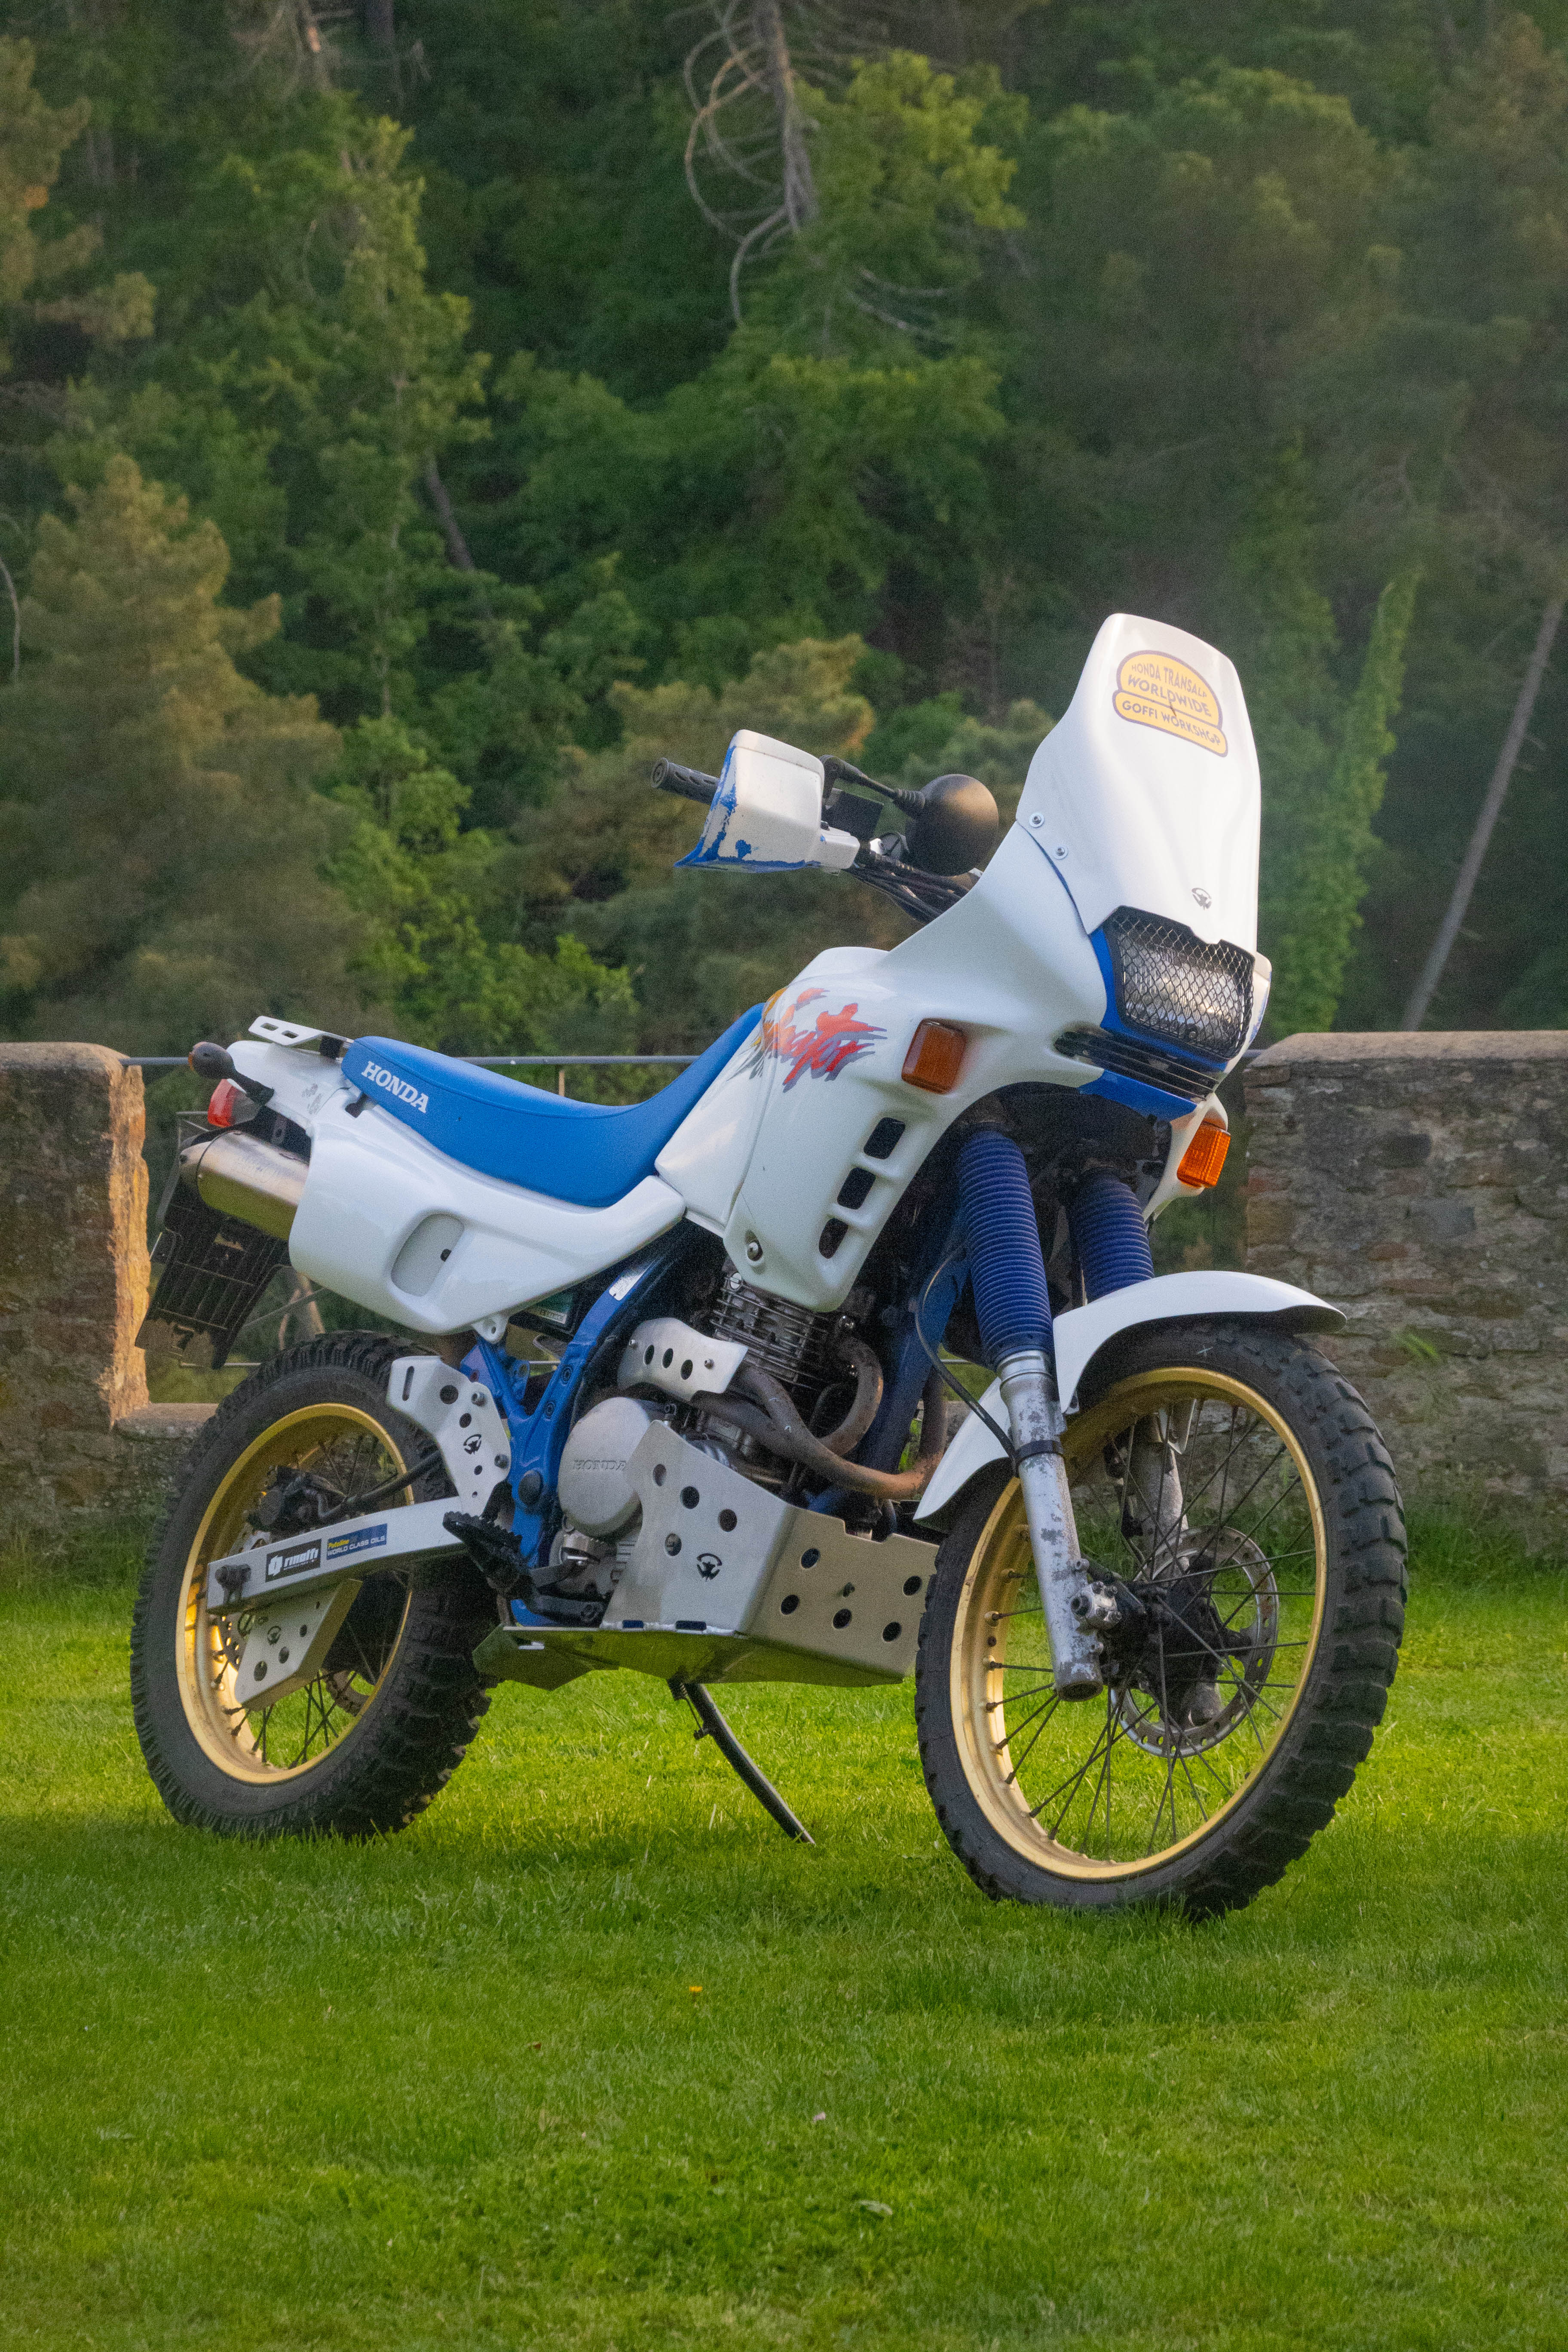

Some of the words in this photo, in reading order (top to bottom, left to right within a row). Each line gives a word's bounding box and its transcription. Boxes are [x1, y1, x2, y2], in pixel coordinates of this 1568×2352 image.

[1128, 674, 1212, 717] WORLDWIDE
[1131, 663, 1161, 681] HONDA
[1164, 666, 1207, 697] TRANSALP
[1122, 700, 1158, 719] GOFFI
[1161, 711, 1221, 745] WORKSHOP
[361, 1060, 429, 1114] HONDA
[573, 1459, 627, 1470] HONDA
[327, 1546, 348, 1556] WORLD
[349, 1539, 369, 1550] CLASS
[371, 1535, 385, 1544] OILS
